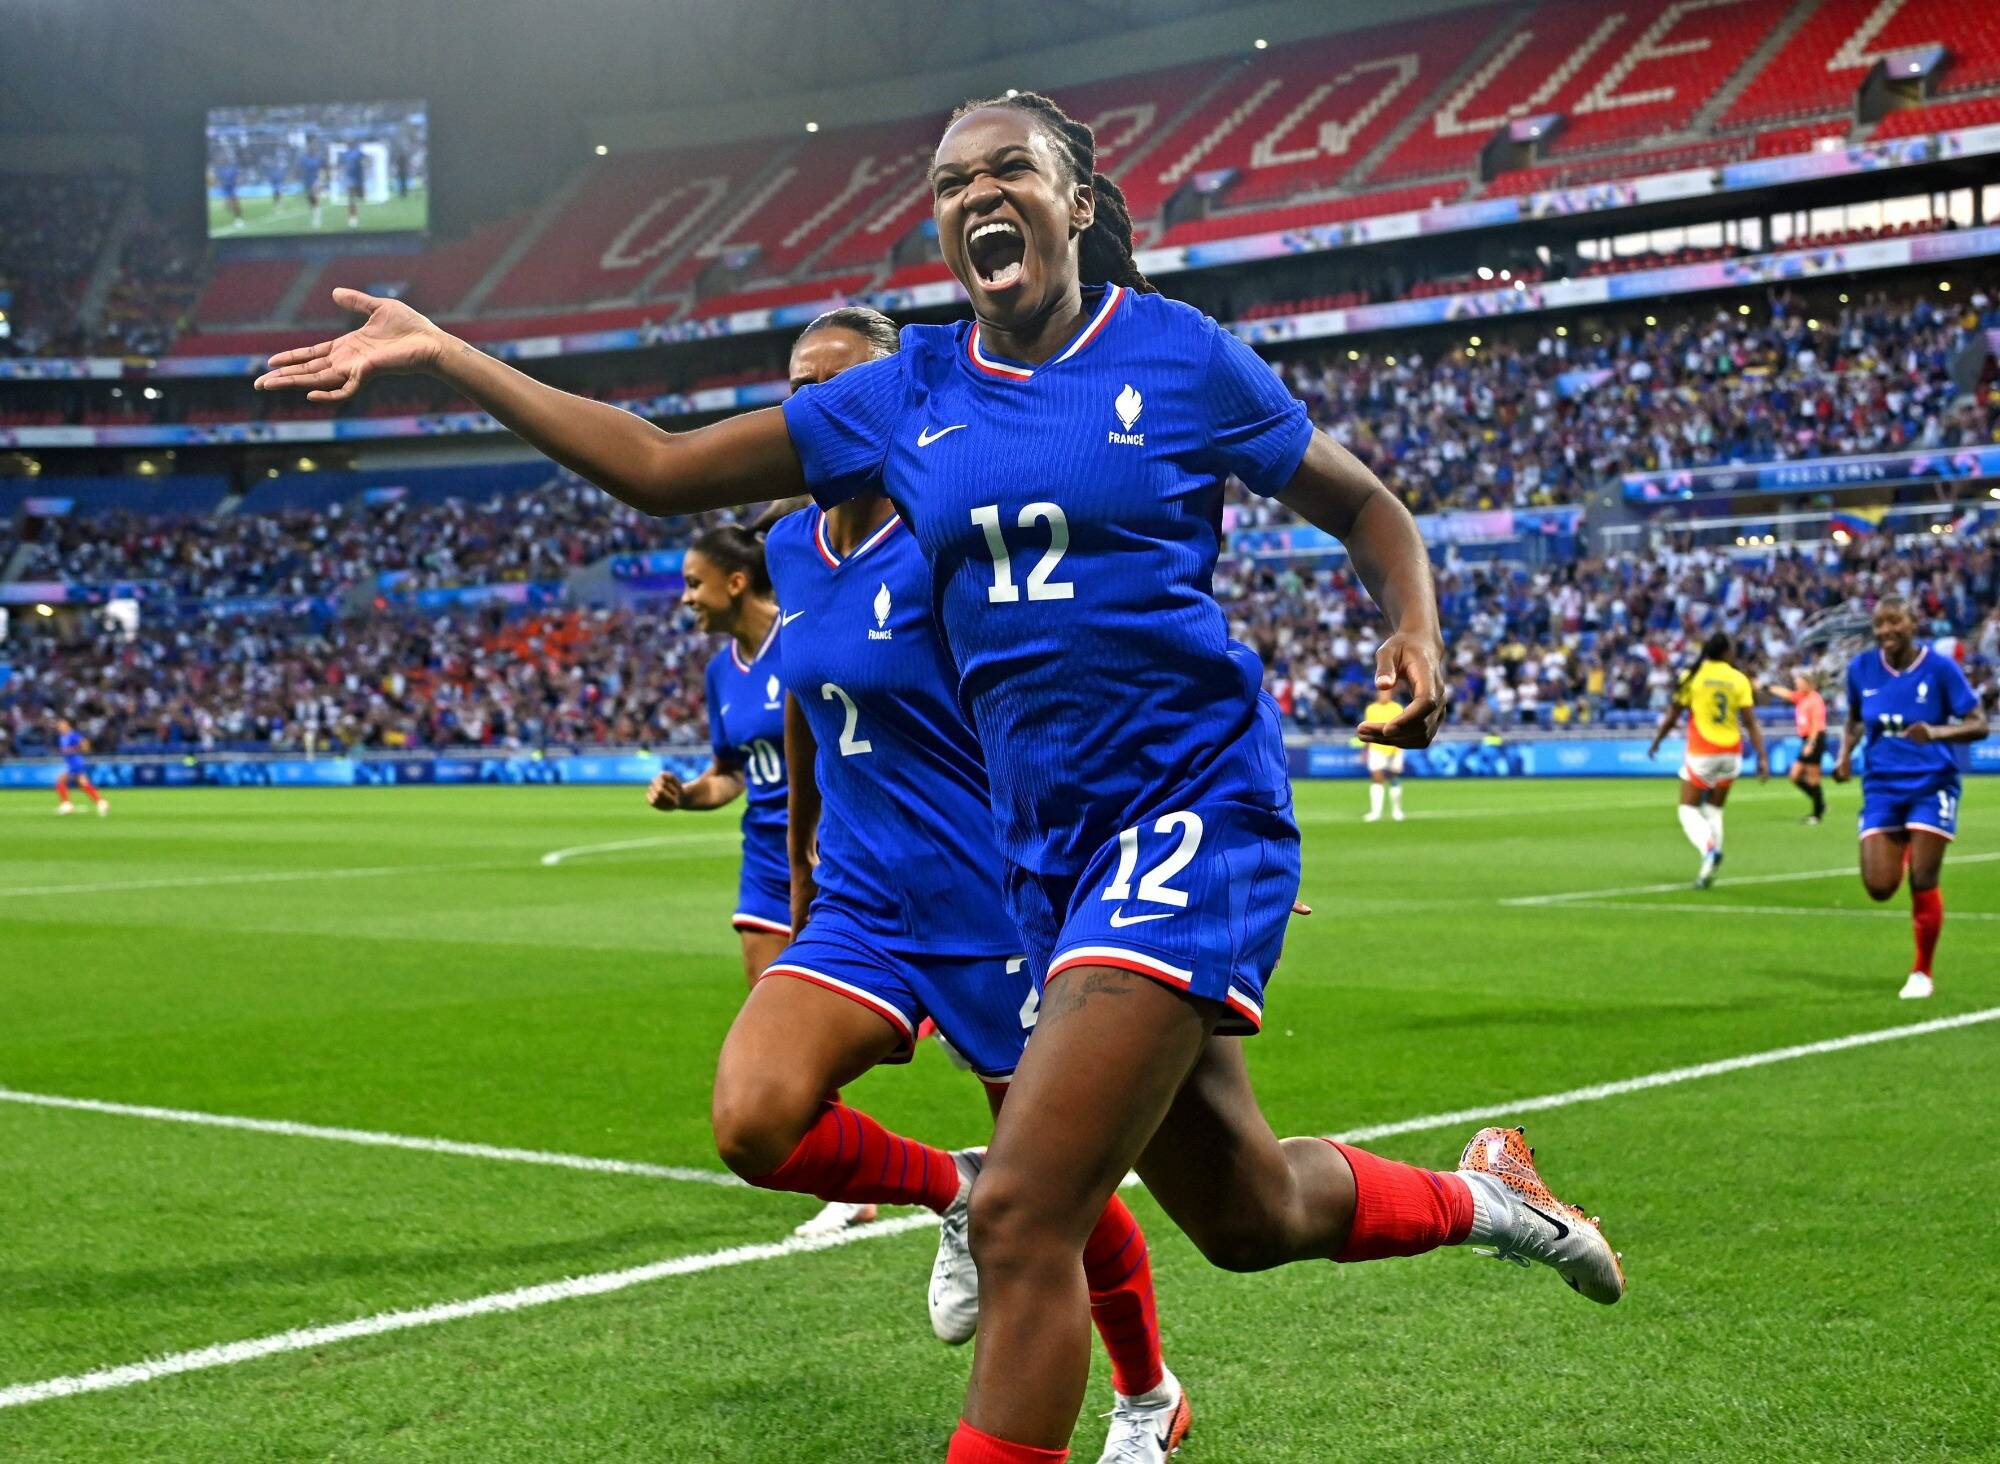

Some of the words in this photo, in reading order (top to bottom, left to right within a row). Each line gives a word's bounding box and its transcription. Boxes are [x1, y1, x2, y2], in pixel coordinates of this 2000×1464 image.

[600, 0, 1750, 270] OLYPIQUE
[1108, 430, 1145, 447] FRANCE
[970, 501, 1075, 603] 12
[867, 629, 893, 640] FRANCE
[821, 683, 873, 757] 2
[1712, 692, 1728, 724] 3
[739, 738, 781, 785] 10
[1101, 810, 1204, 908] 12
